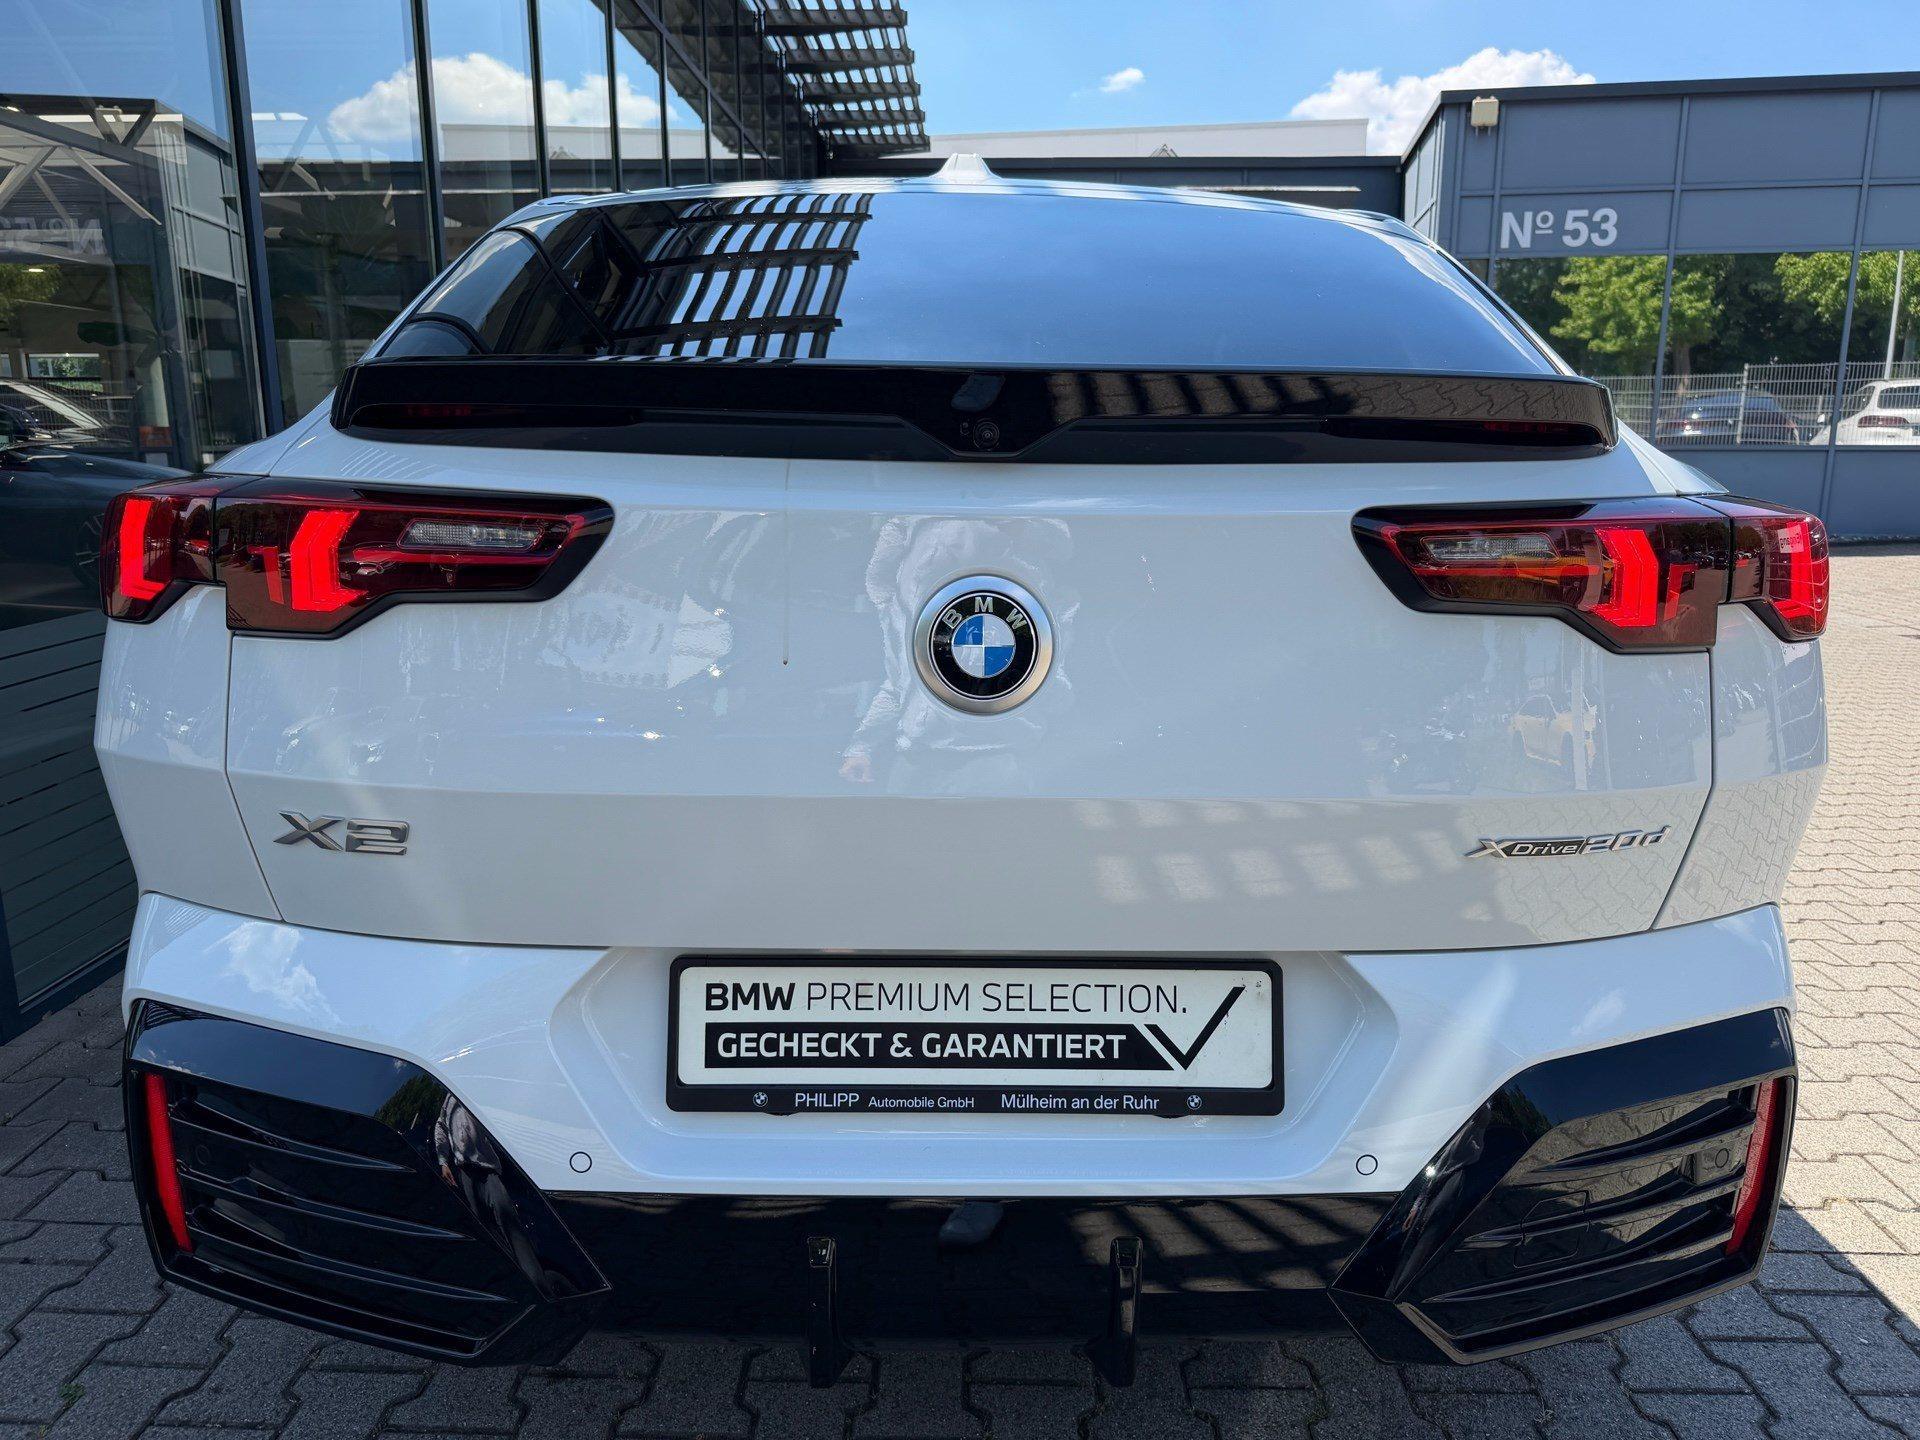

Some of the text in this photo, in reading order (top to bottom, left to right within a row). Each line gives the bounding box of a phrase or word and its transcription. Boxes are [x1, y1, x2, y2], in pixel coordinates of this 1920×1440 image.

[1561, 207, 1618, 248] 53
[942, 596, 1028, 630] BMW
[273, 810, 411, 856] X2
[705, 982, 1187, 1014] BMW PREMIUM SELECTION.
[717, 1032, 1127, 1060] GECHECKT & GARANTIERT
[795, 1092, 1160, 1111] PHILIPP Automobile GmbH Mülheim an der Ruhr
